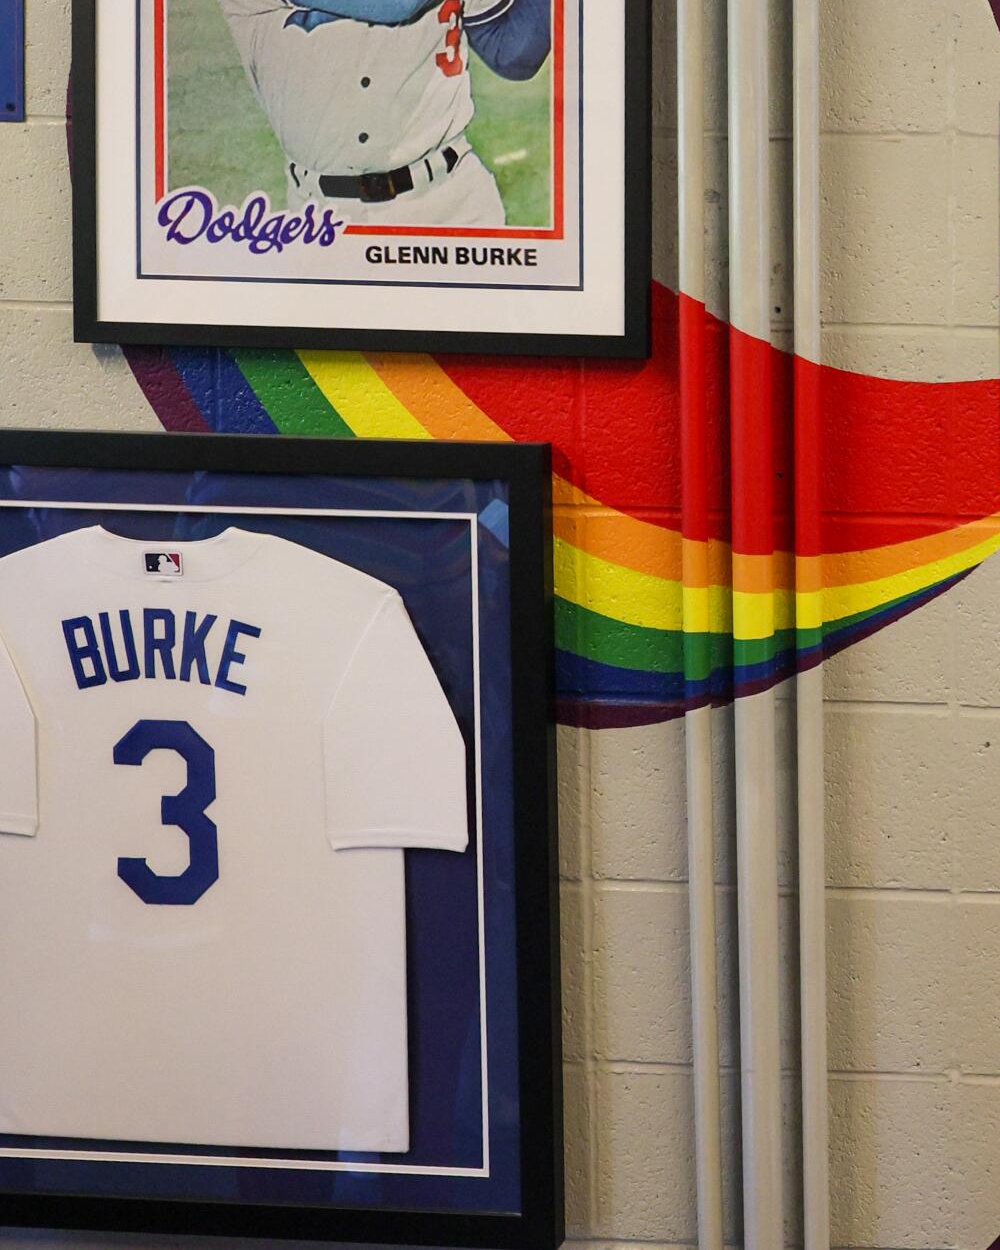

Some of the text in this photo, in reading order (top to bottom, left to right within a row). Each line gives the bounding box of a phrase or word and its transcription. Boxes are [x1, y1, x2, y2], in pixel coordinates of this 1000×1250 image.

[157, 190, 344, 255] Dodgers
[365, 245, 538, 267] GLENN BURKE
[63, 607, 262, 695] BURKE
[112, 719, 220, 906] 3
